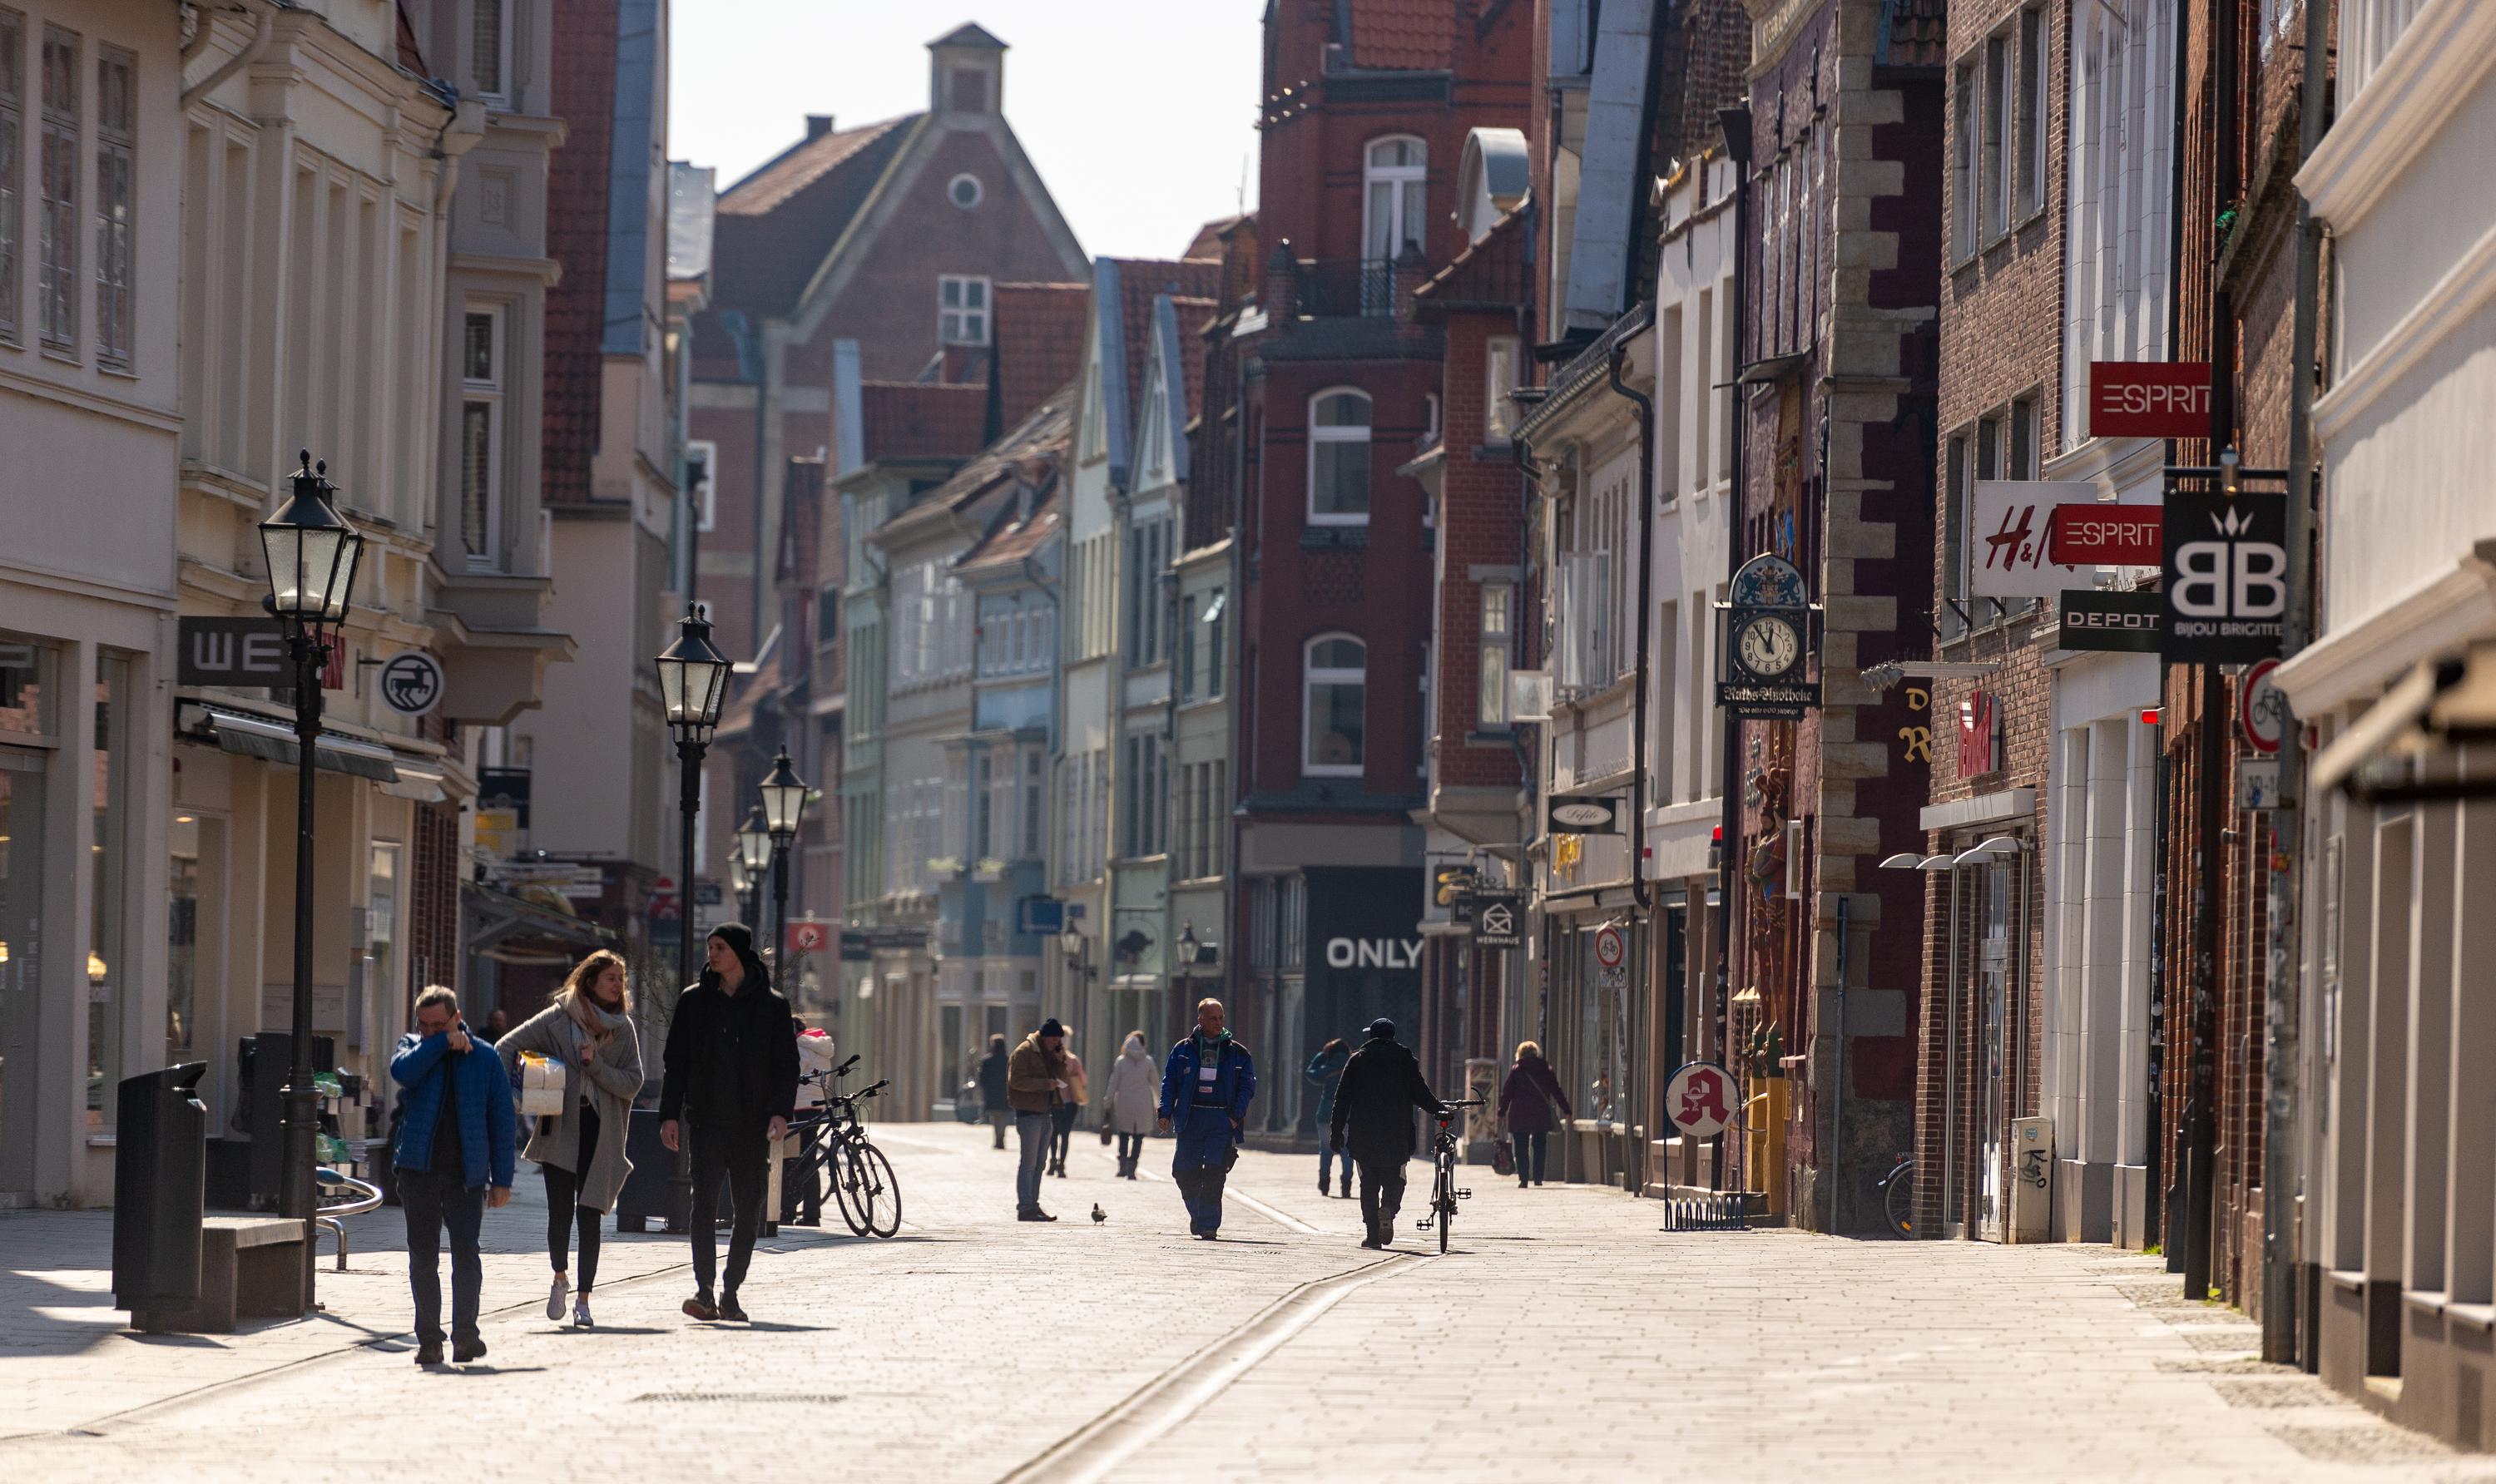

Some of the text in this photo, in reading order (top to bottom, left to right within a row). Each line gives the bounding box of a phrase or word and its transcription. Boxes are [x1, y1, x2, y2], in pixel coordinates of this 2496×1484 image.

[2102, 383, 2212, 413] ESPRIT
[2066, 522, 2160, 546] ESPRIT
[2067, 611, 2160, 629] DEPOT
[2174, 622, 2284, 638] BIJOU BRIGITTE
[193, 631, 282, 672] WE
[1326, 937, 1425, 969] ONLY
